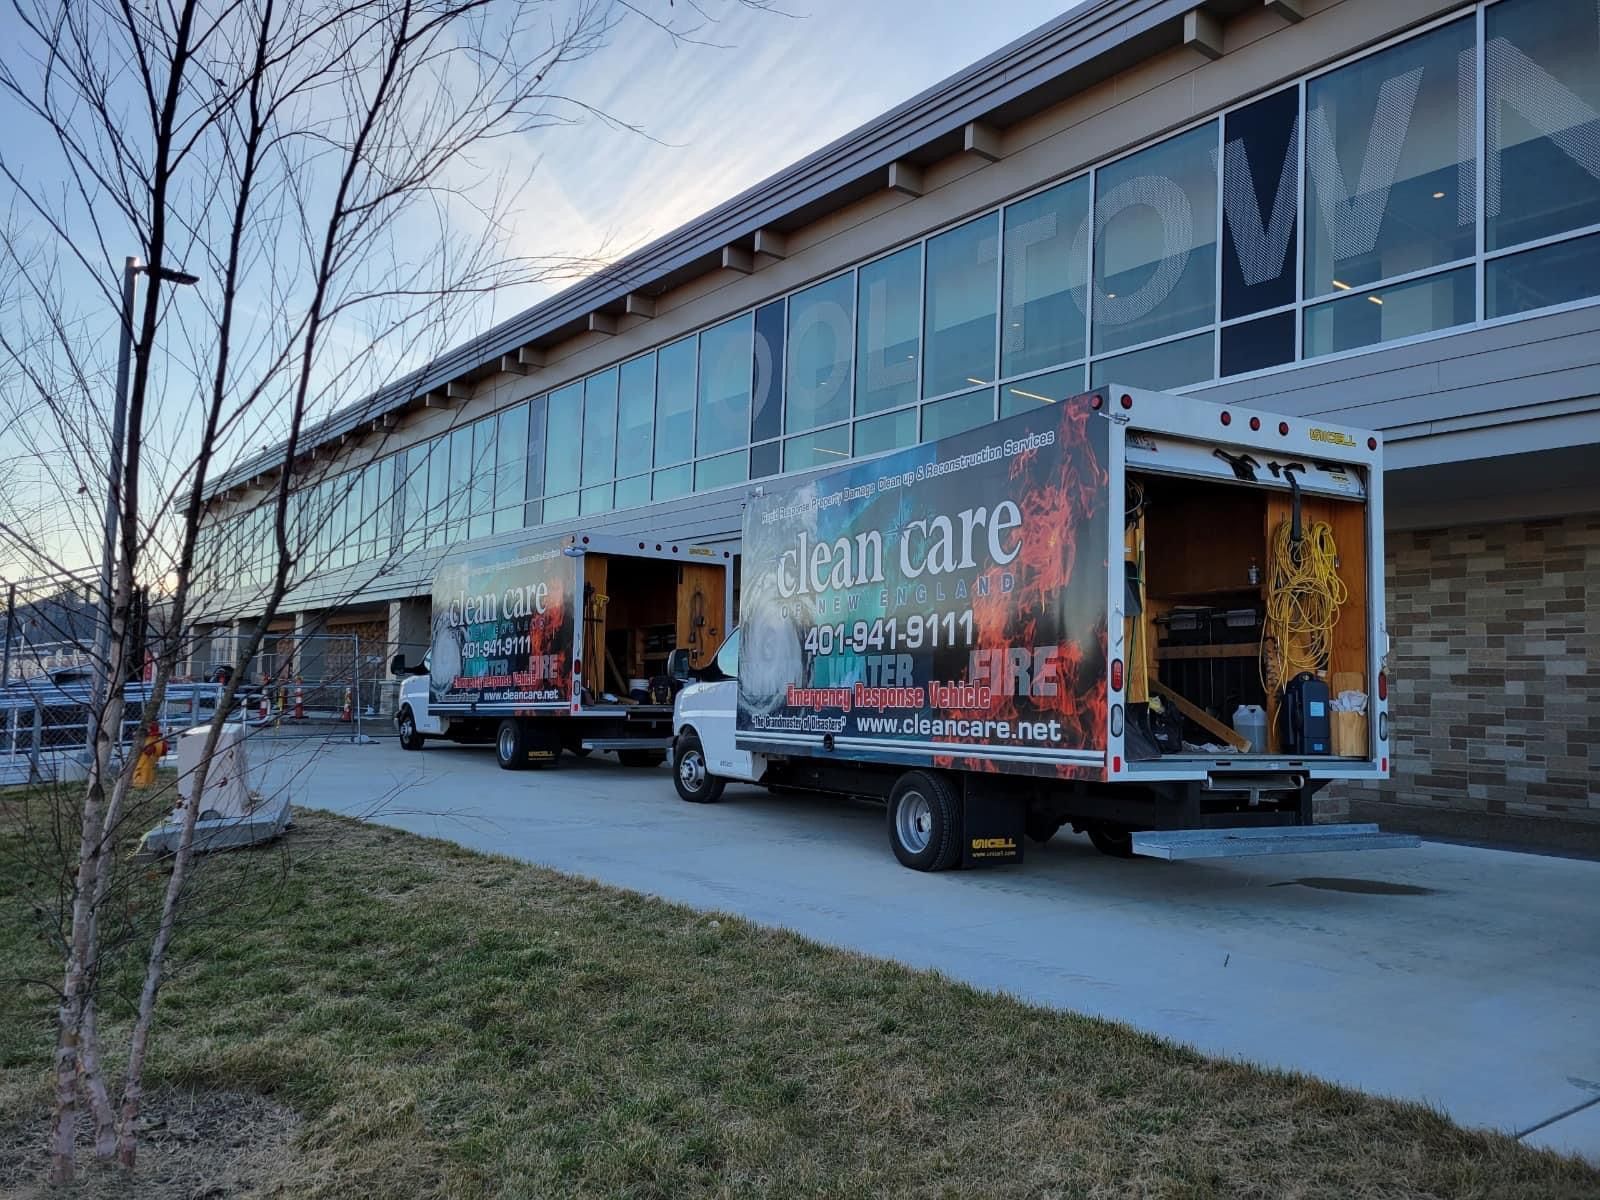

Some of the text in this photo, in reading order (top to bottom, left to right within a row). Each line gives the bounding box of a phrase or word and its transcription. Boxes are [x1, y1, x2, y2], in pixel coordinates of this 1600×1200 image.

[844, 483, 876, 501] Damage
[878, 475, 901, 491] Clean
[902, 472, 914, 487] up
[916, 465, 925, 481] &
[926, 446, 1002, 479] Reconstruction
[1003, 430, 1055, 456] Services
[777, 500, 1024, 599] clean care
[449, 582, 548, 627] clean care
[781, 572, 1016, 619] OF NEW ENGLAND
[461, 635, 532, 658] 401-941-9111
[803, 610, 974, 656] 401-941-9111
[528, 654, 559, 679] FIRE
[969, 646, 1058, 697] FIRE
[484, 688, 559, 701] www.cleancare.net
[786, 680, 992, 713] Emergency Response Vehicle
[765, 714, 802, 730] Grandmaster
[802, 715, 811, 731] of
[856, 714, 1061, 742] www.cleancare.net
